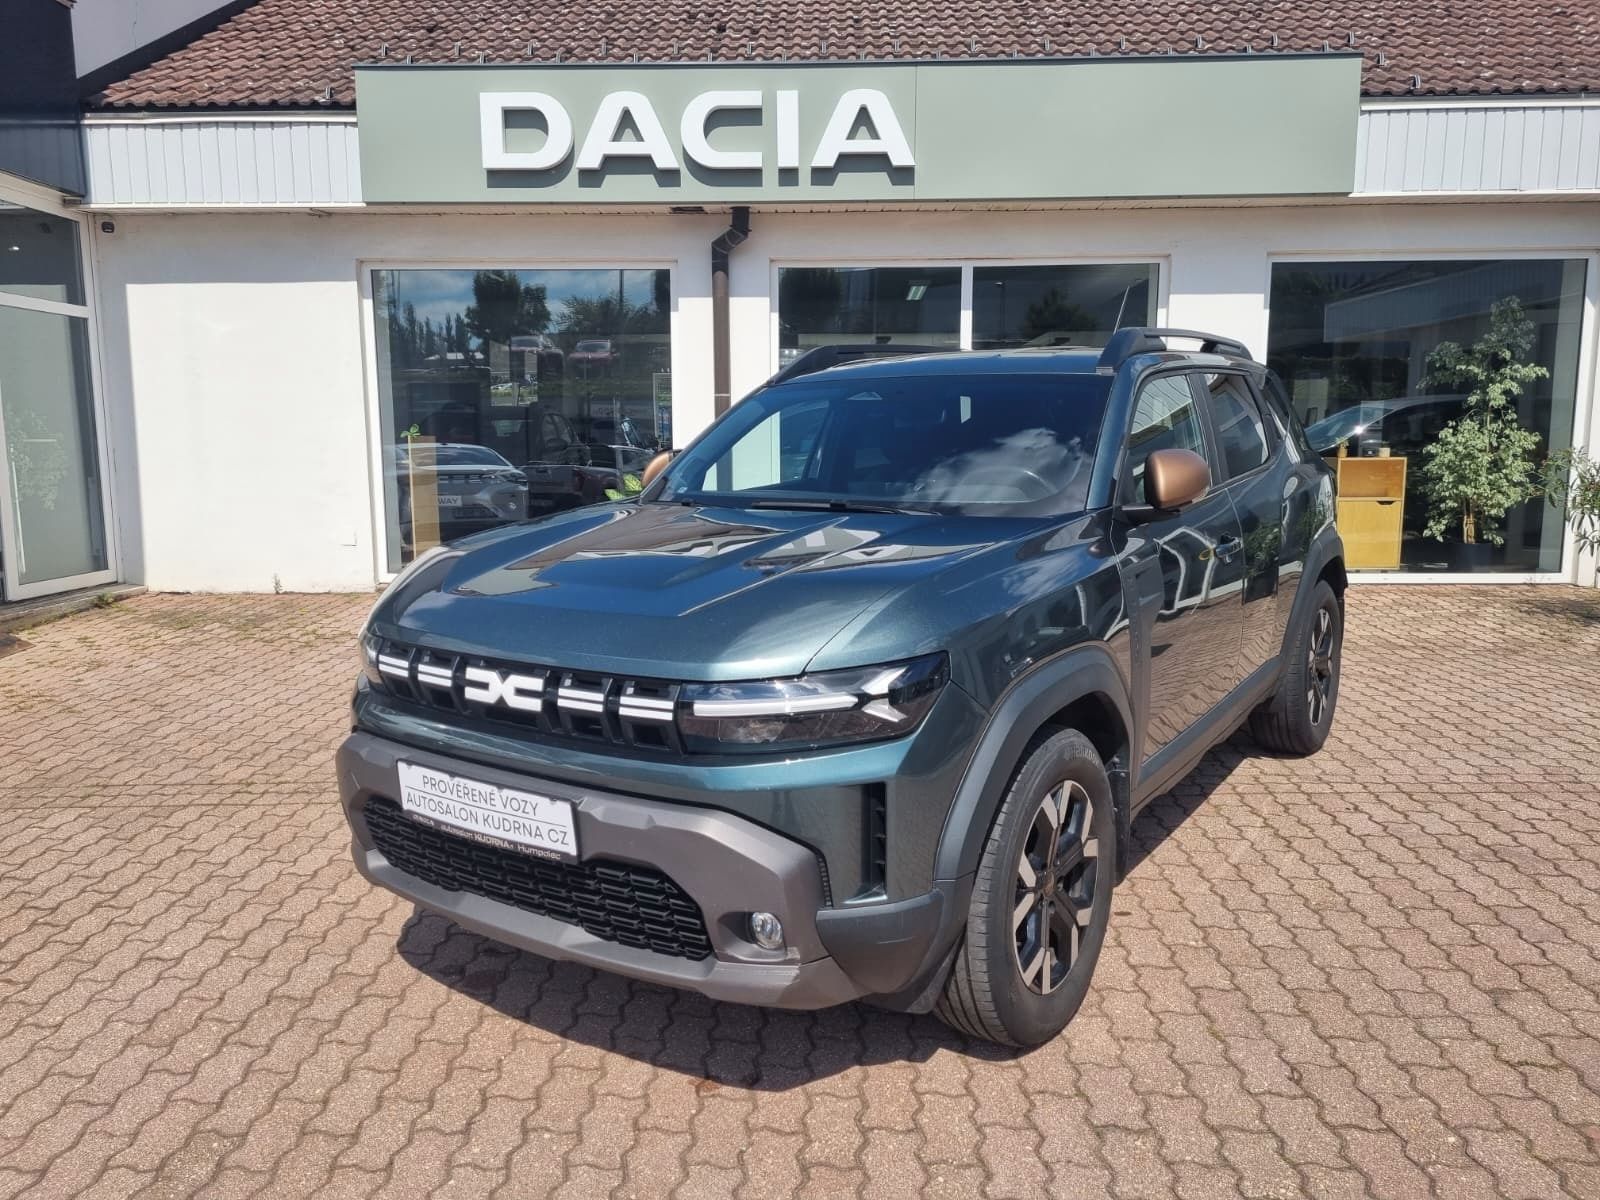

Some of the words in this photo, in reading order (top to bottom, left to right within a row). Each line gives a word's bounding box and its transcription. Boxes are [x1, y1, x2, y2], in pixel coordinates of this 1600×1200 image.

[480, 88, 916, 187] DACIA
[406, 791, 479, 825] AUTOSALON
[482, 812, 544, 841] KUDRNA
[547, 828, 569, 846] CZ
[499, 794, 538, 816] VOZY
